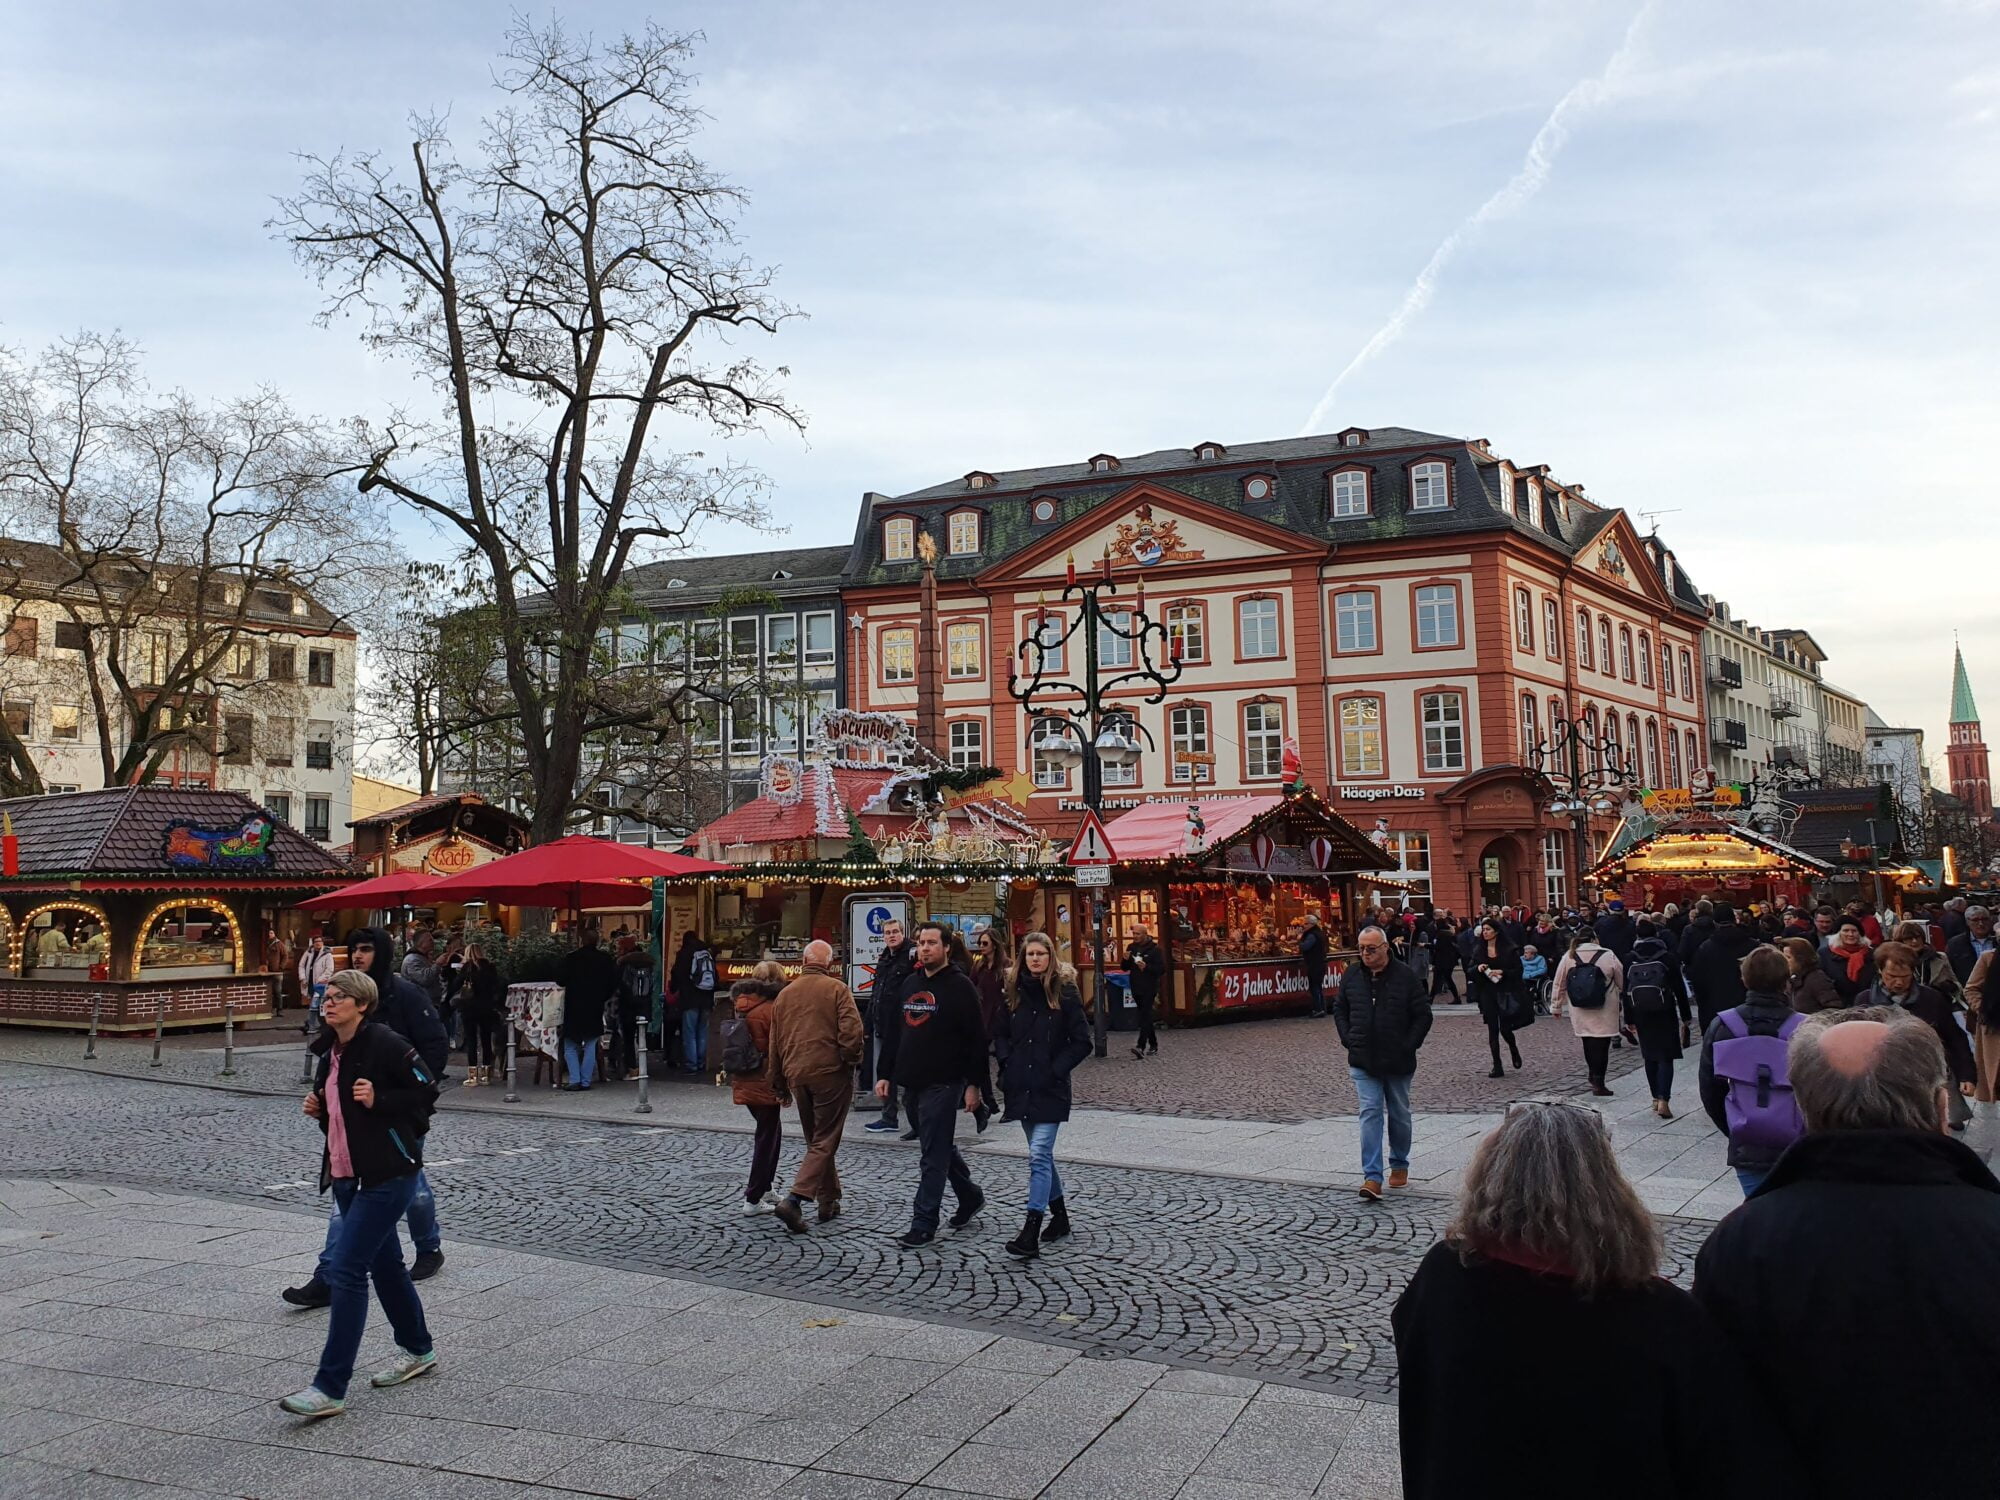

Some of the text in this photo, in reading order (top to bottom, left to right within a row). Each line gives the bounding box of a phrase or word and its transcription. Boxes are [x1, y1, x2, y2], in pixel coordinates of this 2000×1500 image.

[834, 719, 890, 742] BACKHAUS
[1340, 785, 1426, 801] Häagen-Dazs
[1058, 797, 1140, 811] Frafurter
[728, 964, 753, 977] Langos
[1225, 975, 1240, 998] 25
[1243, 972, 1273, 1002] Jahre
